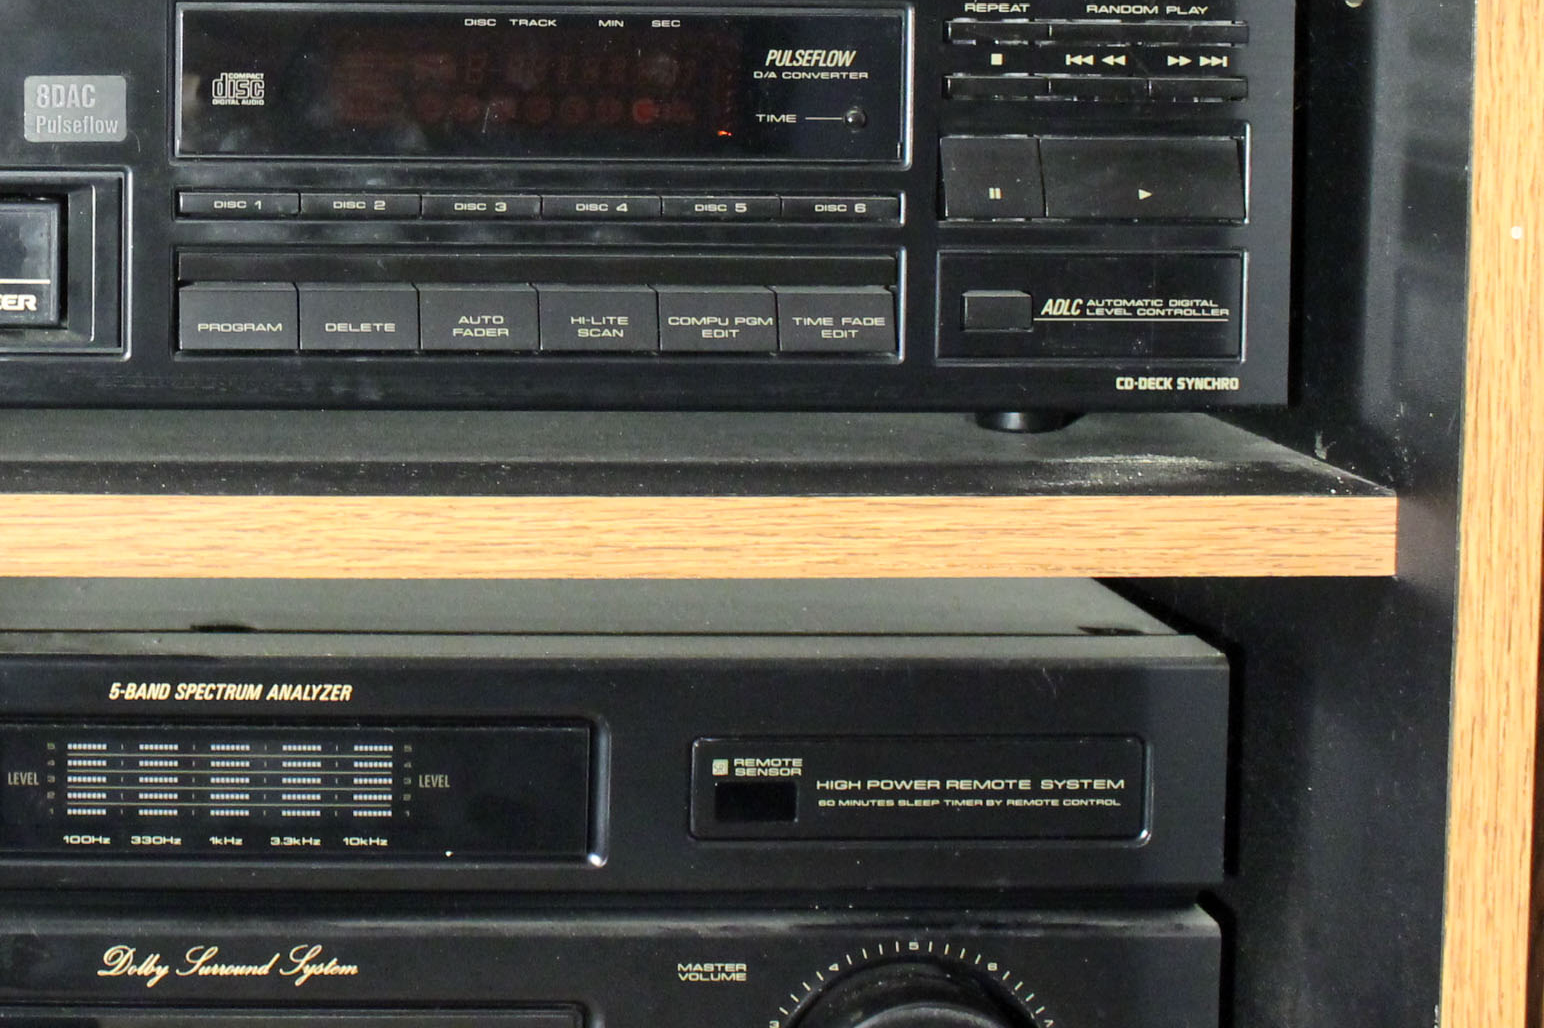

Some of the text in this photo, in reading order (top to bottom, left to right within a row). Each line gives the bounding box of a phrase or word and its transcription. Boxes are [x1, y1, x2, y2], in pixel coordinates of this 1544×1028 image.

[965, 2, 1030, 13] REPEAT
[1086, 5, 1208, 15] RANDOM PLAY
[464, 19, 496, 27] DISC
[509, 19, 556, 28] TRACK
[598, 19, 624, 28] MIN
[651, 19, 681, 28] SEC
[765, 48, 855, 68] PULSEFLOW
[754, 71, 868, 80] D/A CONVERTER
[212, 73, 264, 99] disc
[36, 84, 96, 110] 8DAC
[756, 113, 797, 123] TIME
[35, 114, 119, 136] Pulseflow
[214, 200, 261, 210] DISC 1
[333, 200, 386, 210] DISC 2
[454, 202, 507, 212] DISC 3
[576, 203, 628, 213] DISC 4
[695, 203, 747, 213] DISC 5
[814, 203, 866, 213] DISC 6
[1041, 298, 1083, 316] ADLC
[1086, 299, 1219, 307] AUTOMATIC DIGITAL
[1086, 308, 1229, 316] LEVEL CONTROLLER
[459, 315, 504, 324] AUTO
[571, 316, 629, 325] HI-LITE
[668, 317, 773, 326] COMPU PGM
[792, 317, 886, 326] TIME FADE
[198, 322, 283, 332] PROGRAM
[325, 322, 396, 332] DELETE
[453, 328, 509, 337] FADER
[577, 329, 623, 338] SCAN
[702, 329, 738, 338] EDIT
[821, 329, 858, 339] EDIT
[1176, 377, 1239, 390] SYNCHRO
[109, 683, 353, 701] 5-BAND SPECTRUM ANALYZER
[734, 759, 802, 767] REMOTE
[734, 767, 802, 776] SENSOR
[8, 772, 39, 786] LEVEL
[419, 775, 450, 788] LEVEL
[816, 780, 1125, 790] HIGH POWER REMOTE SYSTEM
[63, 836, 110, 844] 100Hz
[131, 836, 181, 845] 330Hz
[209, 836, 243, 845] 1kHz
[271, 837, 321, 846] 3.3kHz
[343, 837, 388, 846] 10kHz
[97, 944, 358, 987] Dolby Surround System
[678, 963, 747, 972] MASTER
[678, 973, 747, 981] VOLUME
